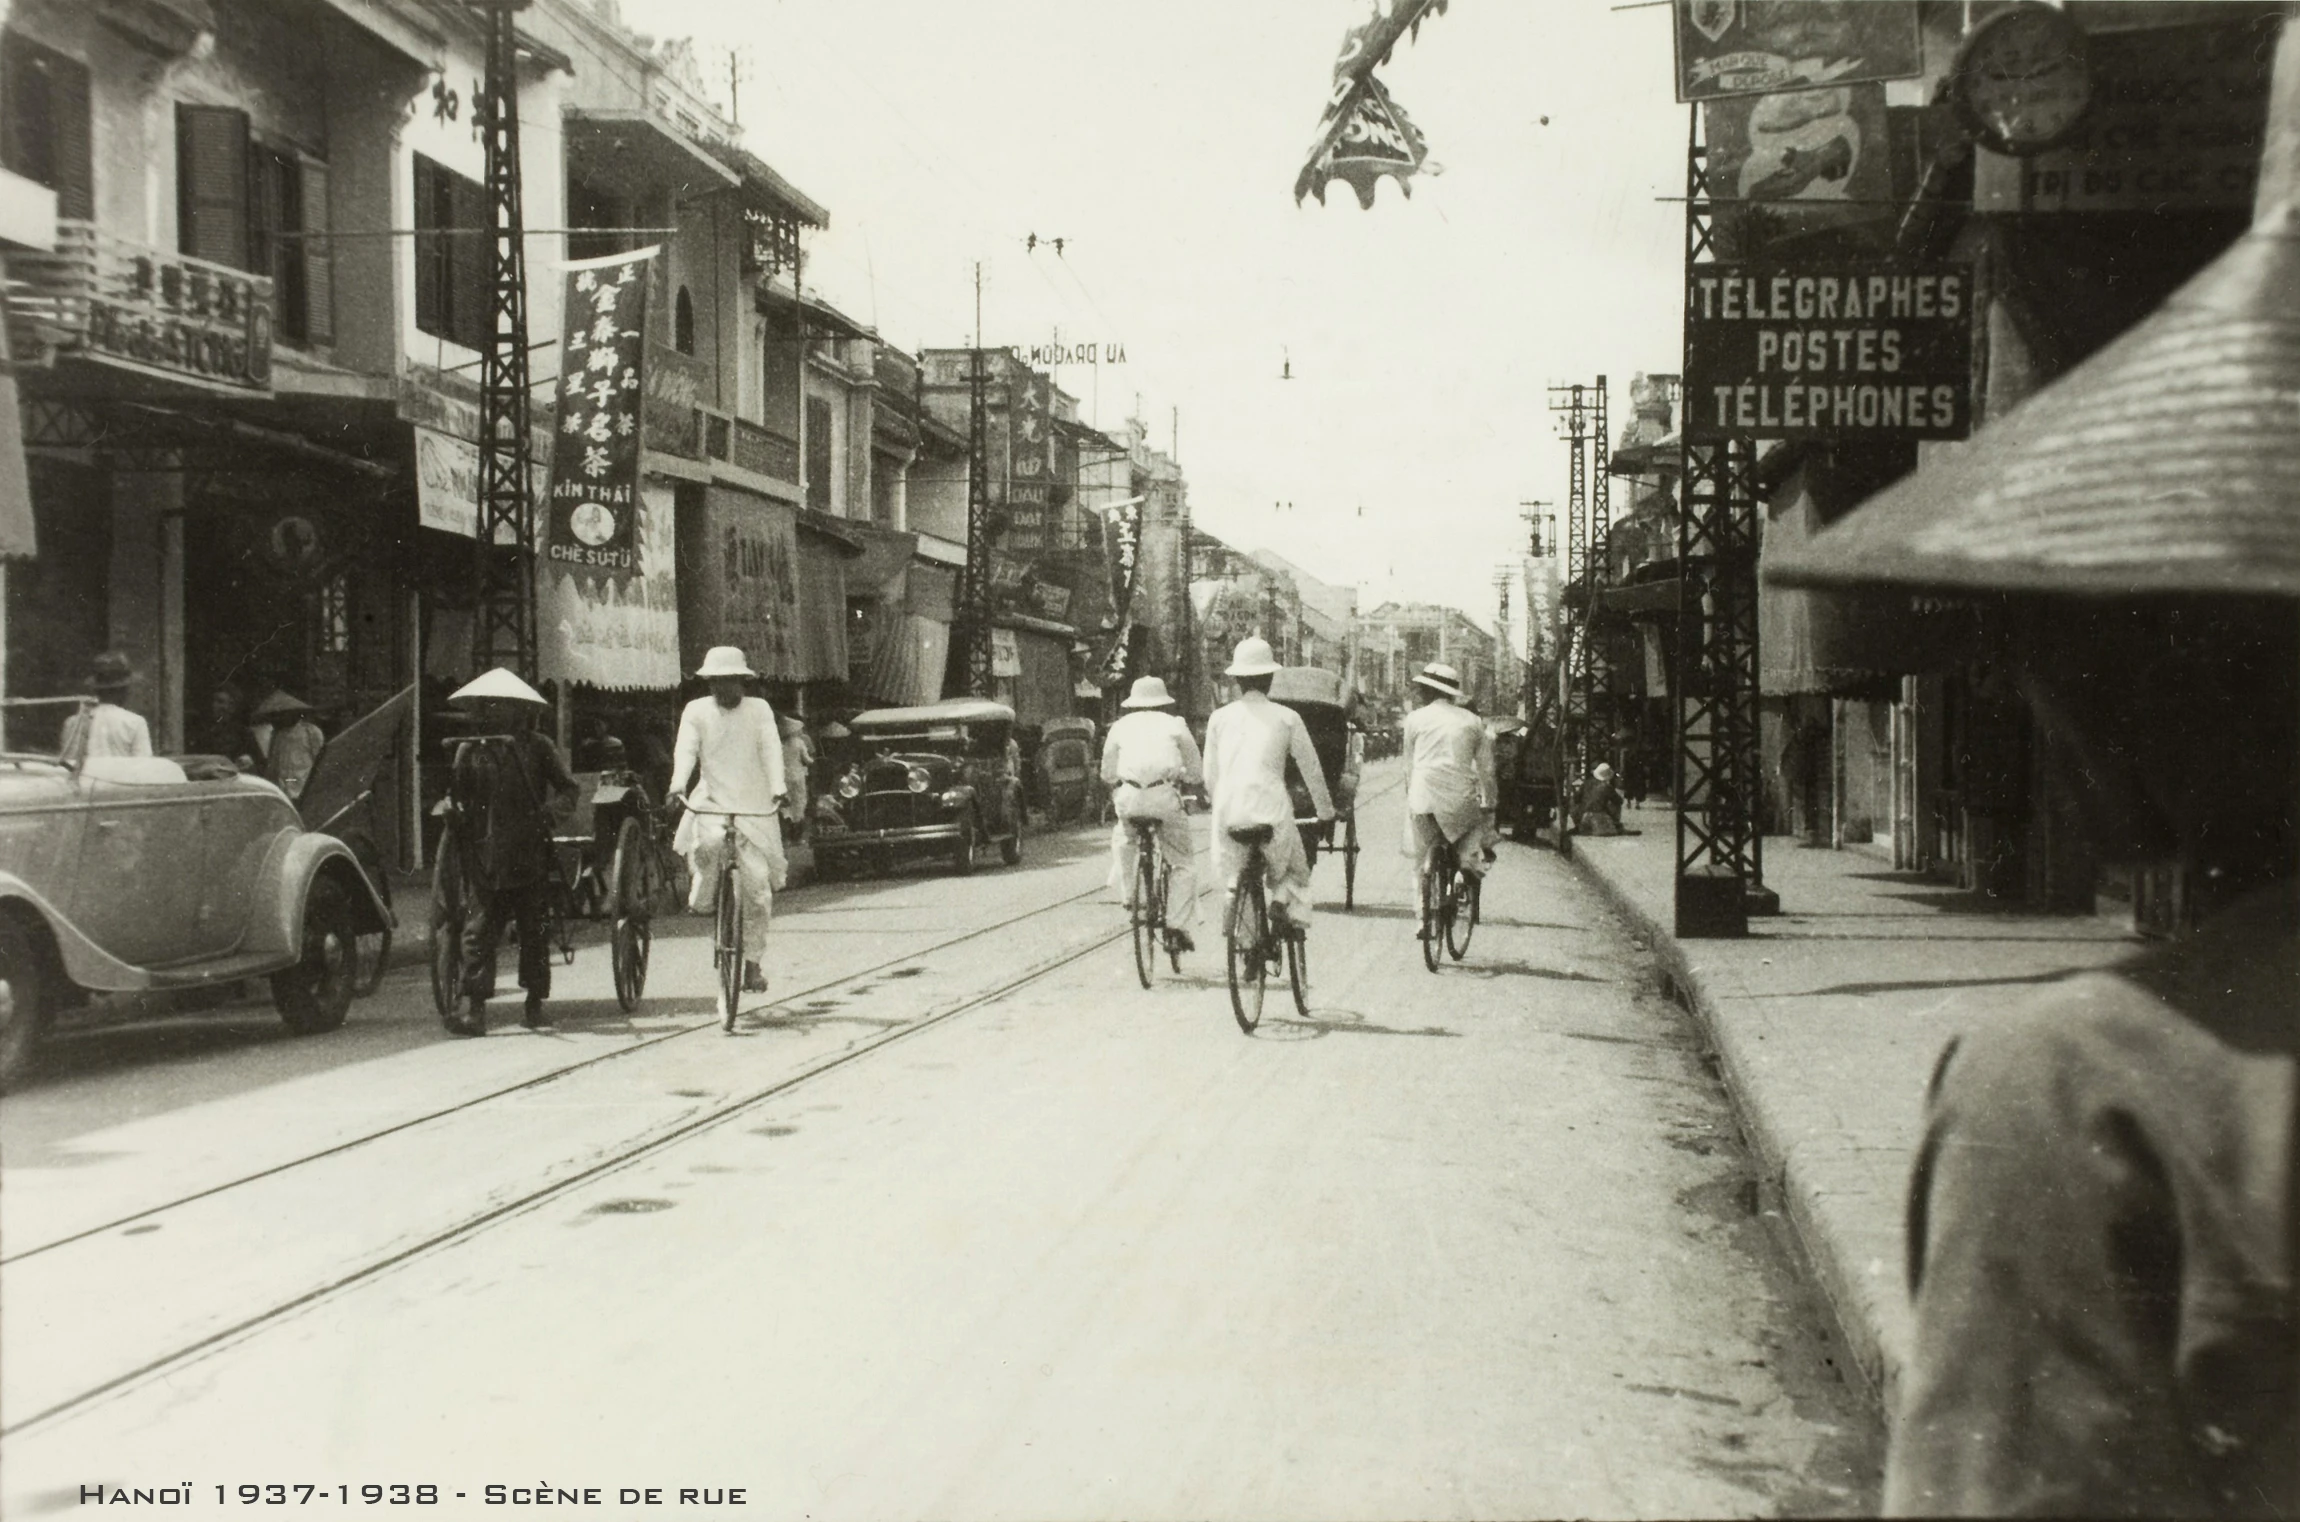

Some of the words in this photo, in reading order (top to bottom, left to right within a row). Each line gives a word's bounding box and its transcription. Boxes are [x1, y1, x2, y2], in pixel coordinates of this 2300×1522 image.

[1700, 268, 1961, 319] TÉLÉGRAPHES
[1758, 330, 1901, 373] POSTES
[1713, 376, 1955, 427] TÉLÉPHONES
